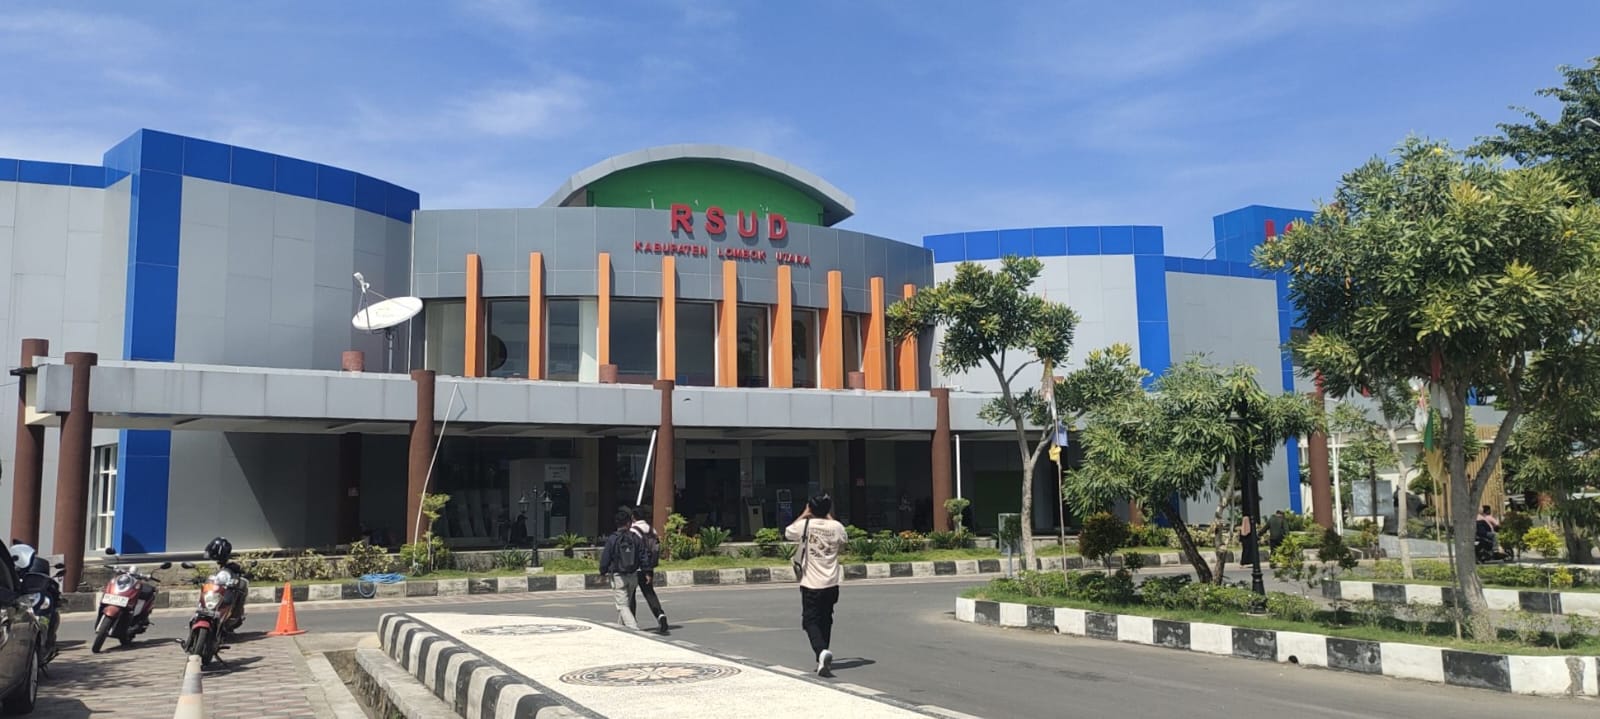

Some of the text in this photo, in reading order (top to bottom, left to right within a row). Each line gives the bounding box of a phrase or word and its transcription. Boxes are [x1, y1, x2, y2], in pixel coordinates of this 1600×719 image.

[671, 203, 788, 239] RSUD
[634, 241, 811, 265] KABUPATEN LOMBOK UTARA
